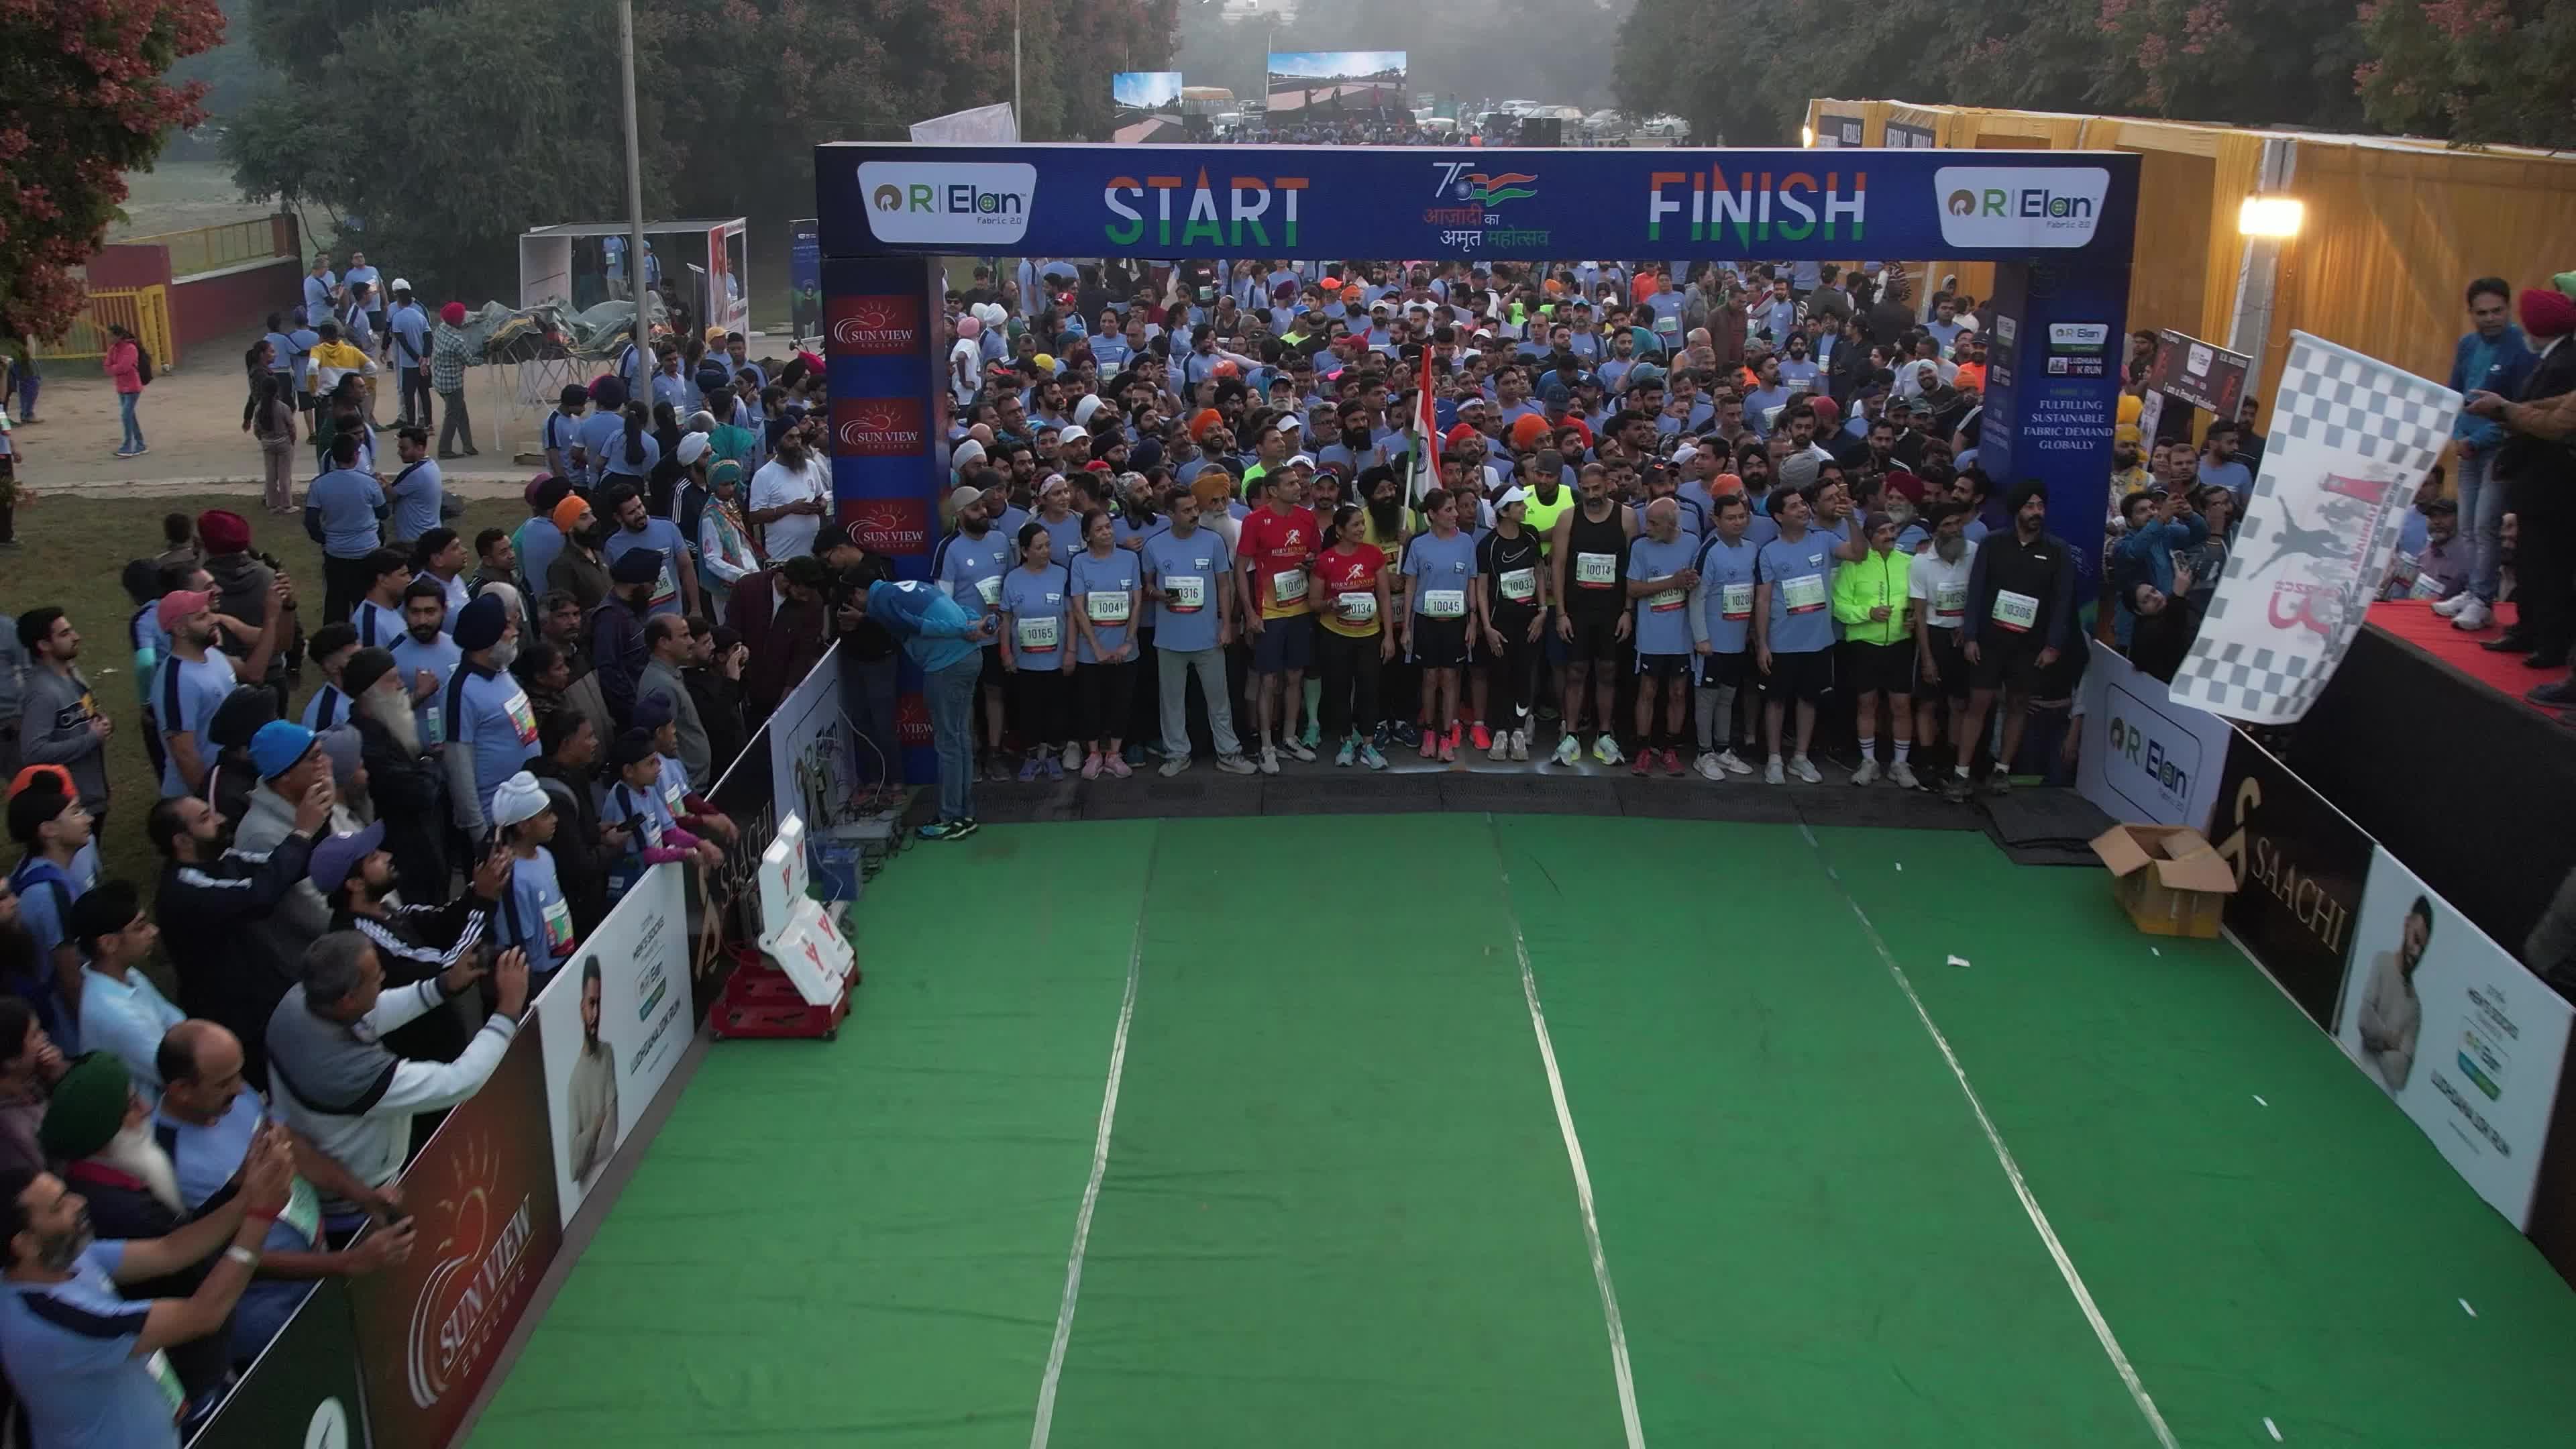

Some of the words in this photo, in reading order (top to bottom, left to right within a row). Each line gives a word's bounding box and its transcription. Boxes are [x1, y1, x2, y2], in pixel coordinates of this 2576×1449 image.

[949, 184, 1022, 214] Elan
[2021, 189, 2092, 218] Elan
[1104, 166, 1310, 248] START
[1648, 160, 1868, 252] FINISH
[977, 216, 1006, 225] Fabric
[1484, 213, 1500, 226] का
[2046, 220, 2076, 229] Fabric
[1440, 229, 1482, 249] अमृत
[851, 329, 877, 341] SUN
[880, 329, 913, 340] VIEW
[2039, 400, 2104, 410] FULFILLING
[2031, 413, 2105, 424] SUSTAINABLE
[857, 431, 883, 443] SUN
[885, 431, 918, 442] VIEW
[2023, 427, 2062, 437] FABRIC
[2065, 427, 2114, 437] DEMAND
[2039, 440, 2096, 450] GLOBALLY
[863, 532, 890, 543] SUN
[891, 531, 924, 542] VIEW
[1509, 577, 1534, 592] 10032
[1179, 588, 1199, 598] 0316
[1099, 603, 1124, 613] 10041
[1433, 600, 1460, 612] 10045
[1026, 627, 1053, 640] 10165
[2252, 836, 2349, 955] SAACHI
[439, 1274, 483, 1371] SUN
[480, 1191, 532, 1291] VIEW
